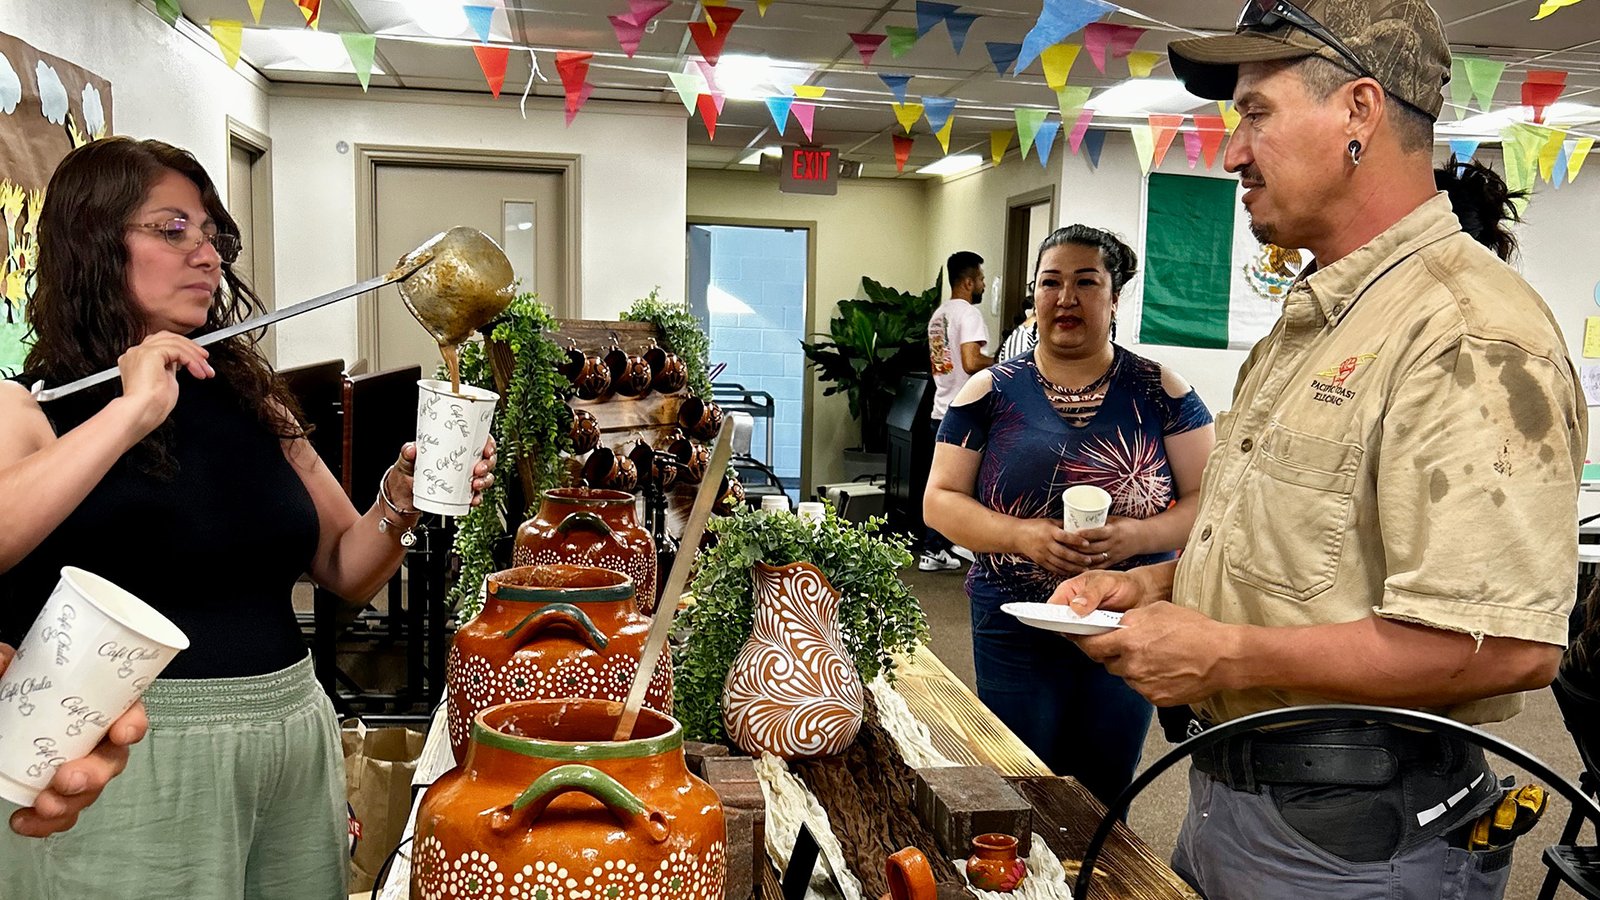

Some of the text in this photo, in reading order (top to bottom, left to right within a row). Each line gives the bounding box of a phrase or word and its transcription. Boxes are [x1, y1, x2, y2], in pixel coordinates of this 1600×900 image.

[792, 150, 831, 181] EXIT
[98, 641, 128, 662] Café
[20, 675, 53, 696] Chula
[61, 696, 90, 716] Café
[33, 737, 57, 760] Café
